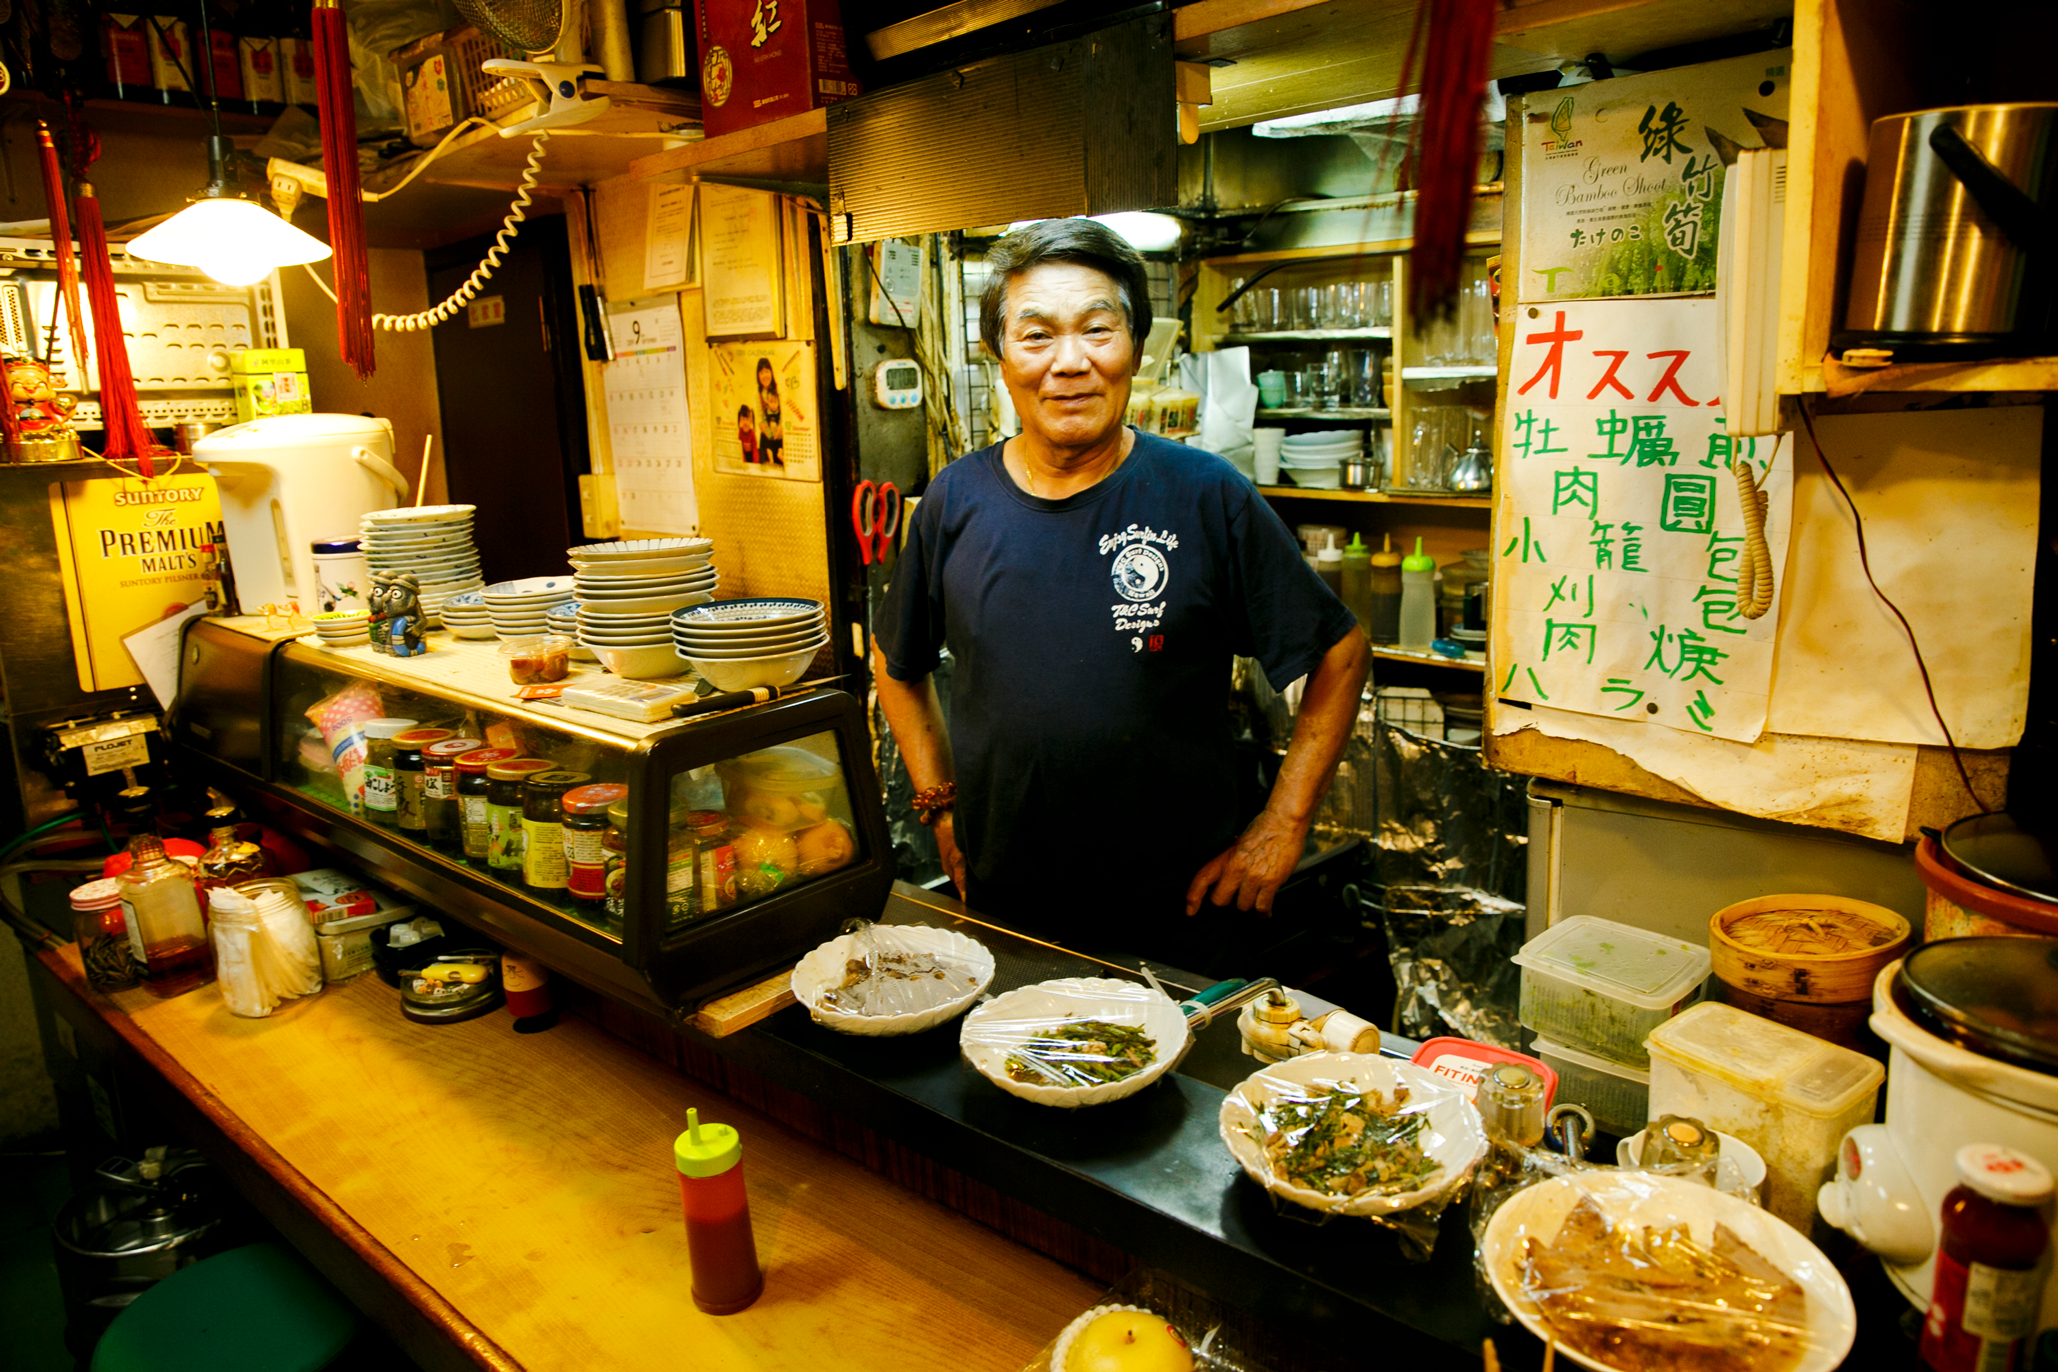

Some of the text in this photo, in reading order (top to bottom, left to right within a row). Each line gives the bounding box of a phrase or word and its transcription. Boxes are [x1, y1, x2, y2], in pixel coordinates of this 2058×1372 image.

[1583, 156, 1628, 185] Green
[1556, 174, 1667, 206] Bamboo Shoot
[1570, 226, 1642, 249] たけのこ
[632, 320, 641, 345] 9
[1517, 311, 1720, 407] オスス
[115, 487, 204, 507] SUNTORY
[1552, 466, 1717, 535] 肉圓
[142, 507, 178, 528] The
[98, 520, 225, 558] PREMIUM
[1098, 531, 1128, 556] Enjoy
[1155, 529, 1180, 552] Life
[1502, 517, 1746, 584] 小籠包
[141, 553, 197, 575] MALT'S
[120, 577, 163, 589] SUNTORY
[1136, 601, 1167, 619] Surf
[1114, 617, 1161, 634] Designs
[94, 739, 132, 752] FLOJET
[1434, 1064, 1462, 1079] FIT
